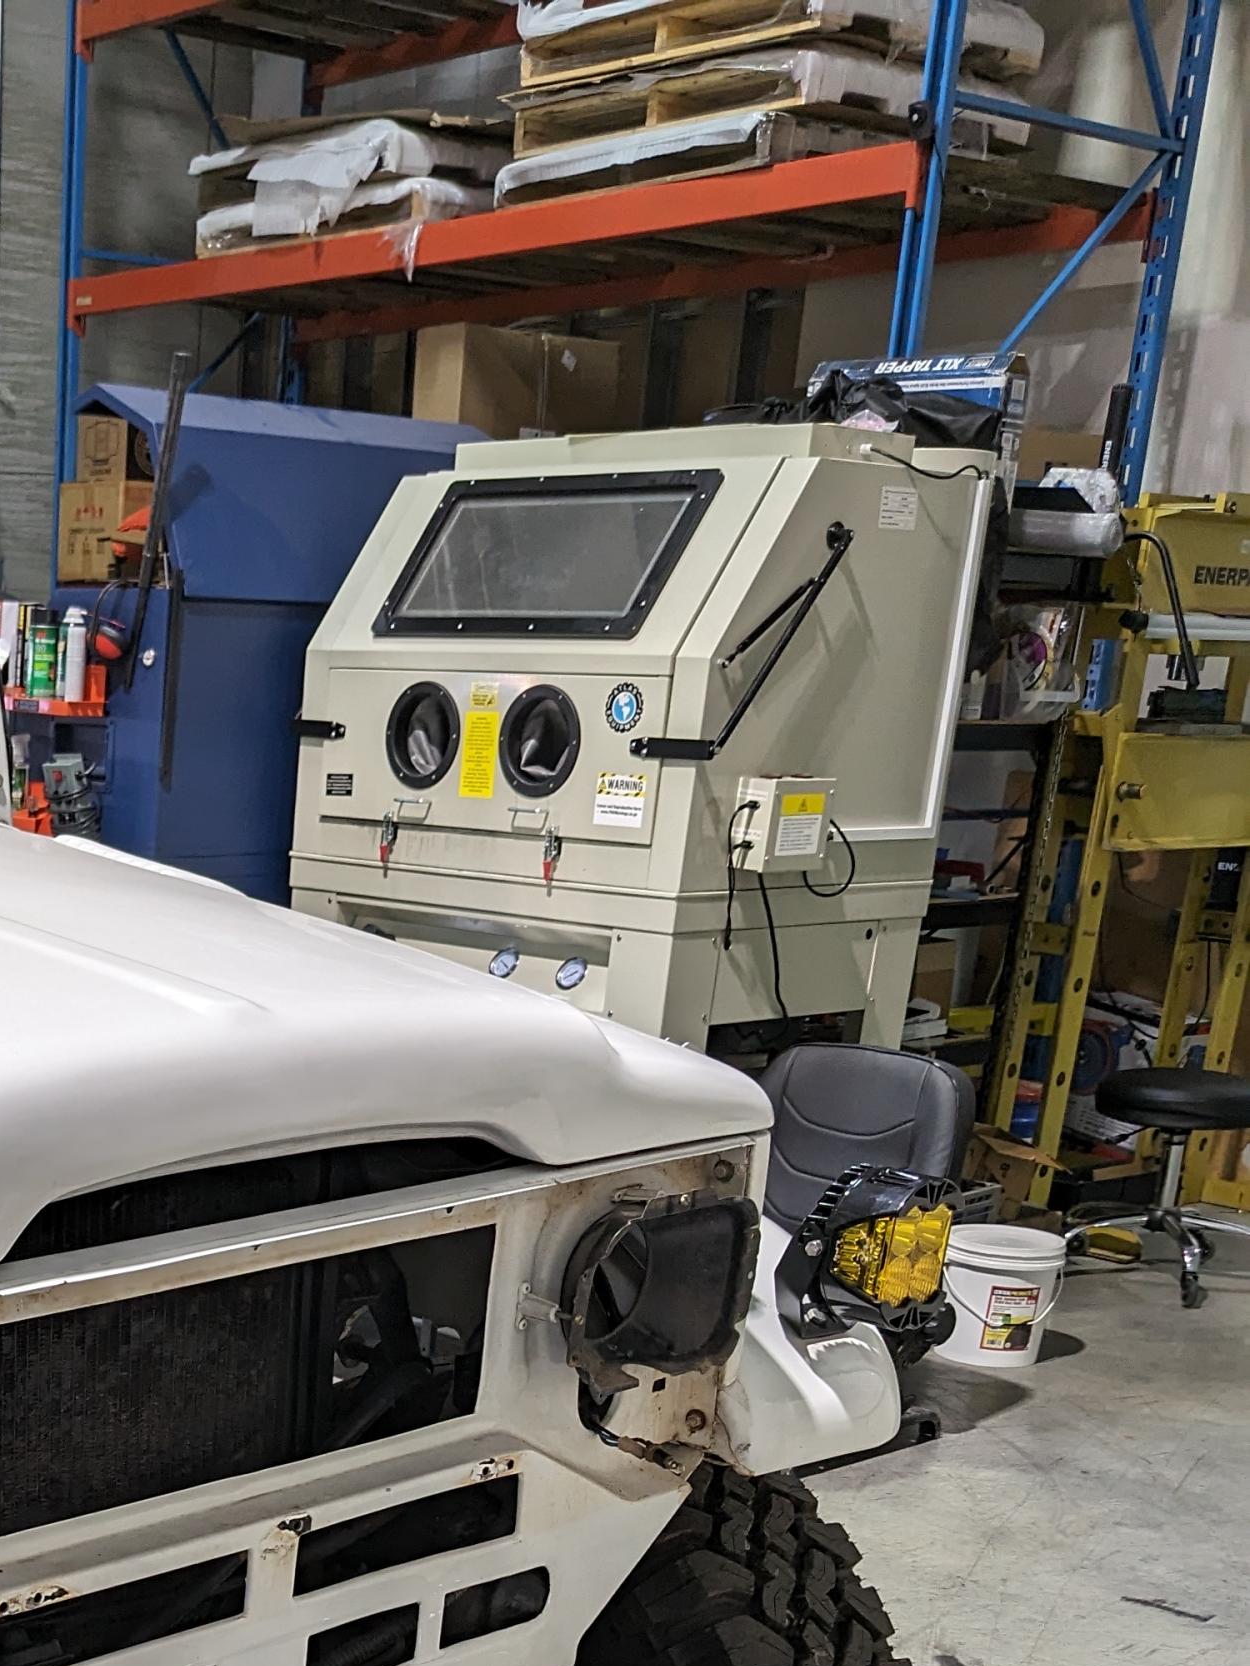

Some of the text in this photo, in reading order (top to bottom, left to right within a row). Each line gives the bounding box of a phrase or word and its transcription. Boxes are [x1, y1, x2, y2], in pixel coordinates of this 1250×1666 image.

[874, 359, 933, 375] TAPPER
[932, 357, 965, 371] XLT
[608, 779, 644, 792] WARNING
